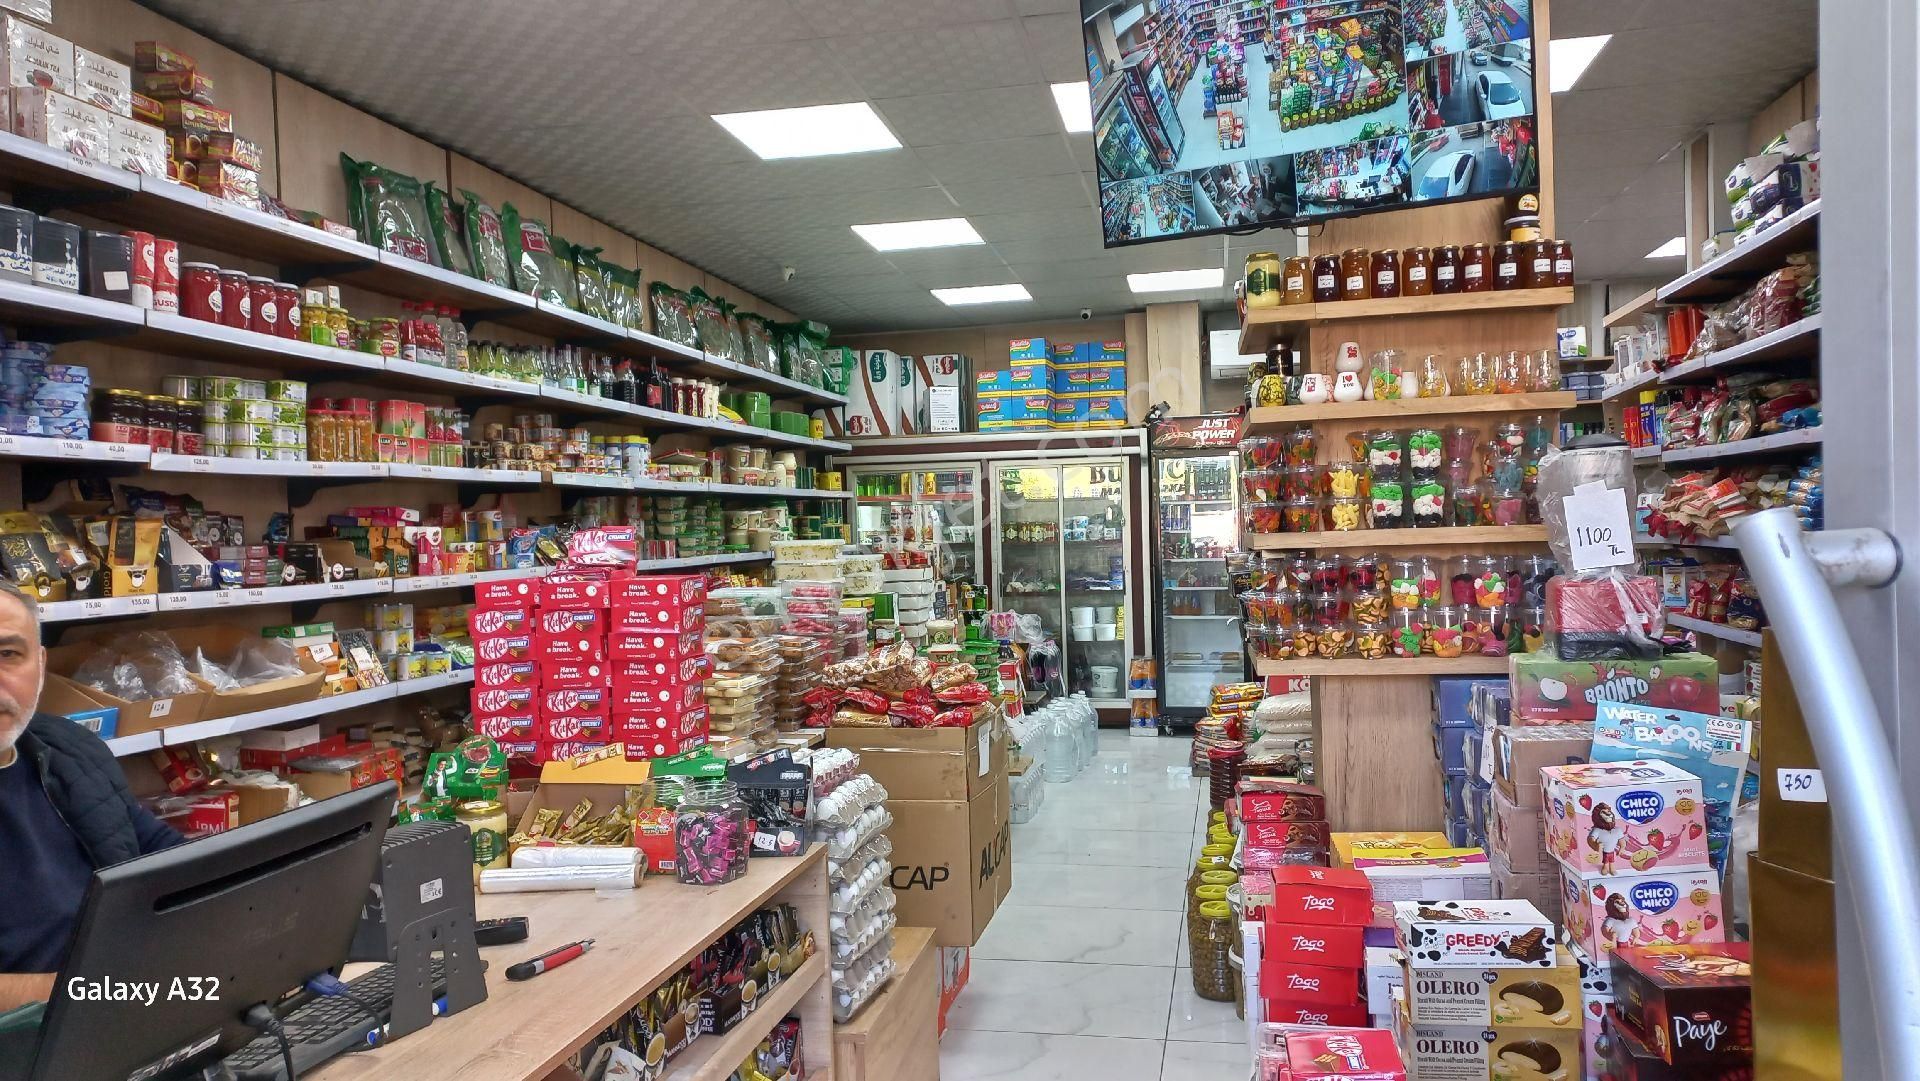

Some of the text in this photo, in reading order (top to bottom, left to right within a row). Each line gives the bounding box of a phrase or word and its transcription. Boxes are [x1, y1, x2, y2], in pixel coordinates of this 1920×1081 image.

[1201, 418, 1231, 428] JUST
[1192, 429, 1236, 439] POWER
[1576, 526, 1625, 556] 1100 TL
[479, 611, 504, 633] KitKat
[547, 611, 573, 633] KitKat
[483, 638, 508, 660] KitKat
[481, 690, 509, 712] KitKat
[551, 690, 578, 712] KitKat
[1602, 706, 1658, 725] WATER
[484, 717, 511, 738] KitKat
[553, 717, 580, 739] KitKat
[1621, 797, 1659, 808] CHICO
[1627, 807, 1656, 818] MIKO
[1635, 887, 1673, 898] CHICO
[1641, 898, 1670, 908] MIKO
[1446, 933, 1500, 947] GREEDY
[1416, 980, 1480, 996] OLERO
[1673, 1016, 1728, 1051] Paye
[1416, 1039, 1480, 1055] OLERO
